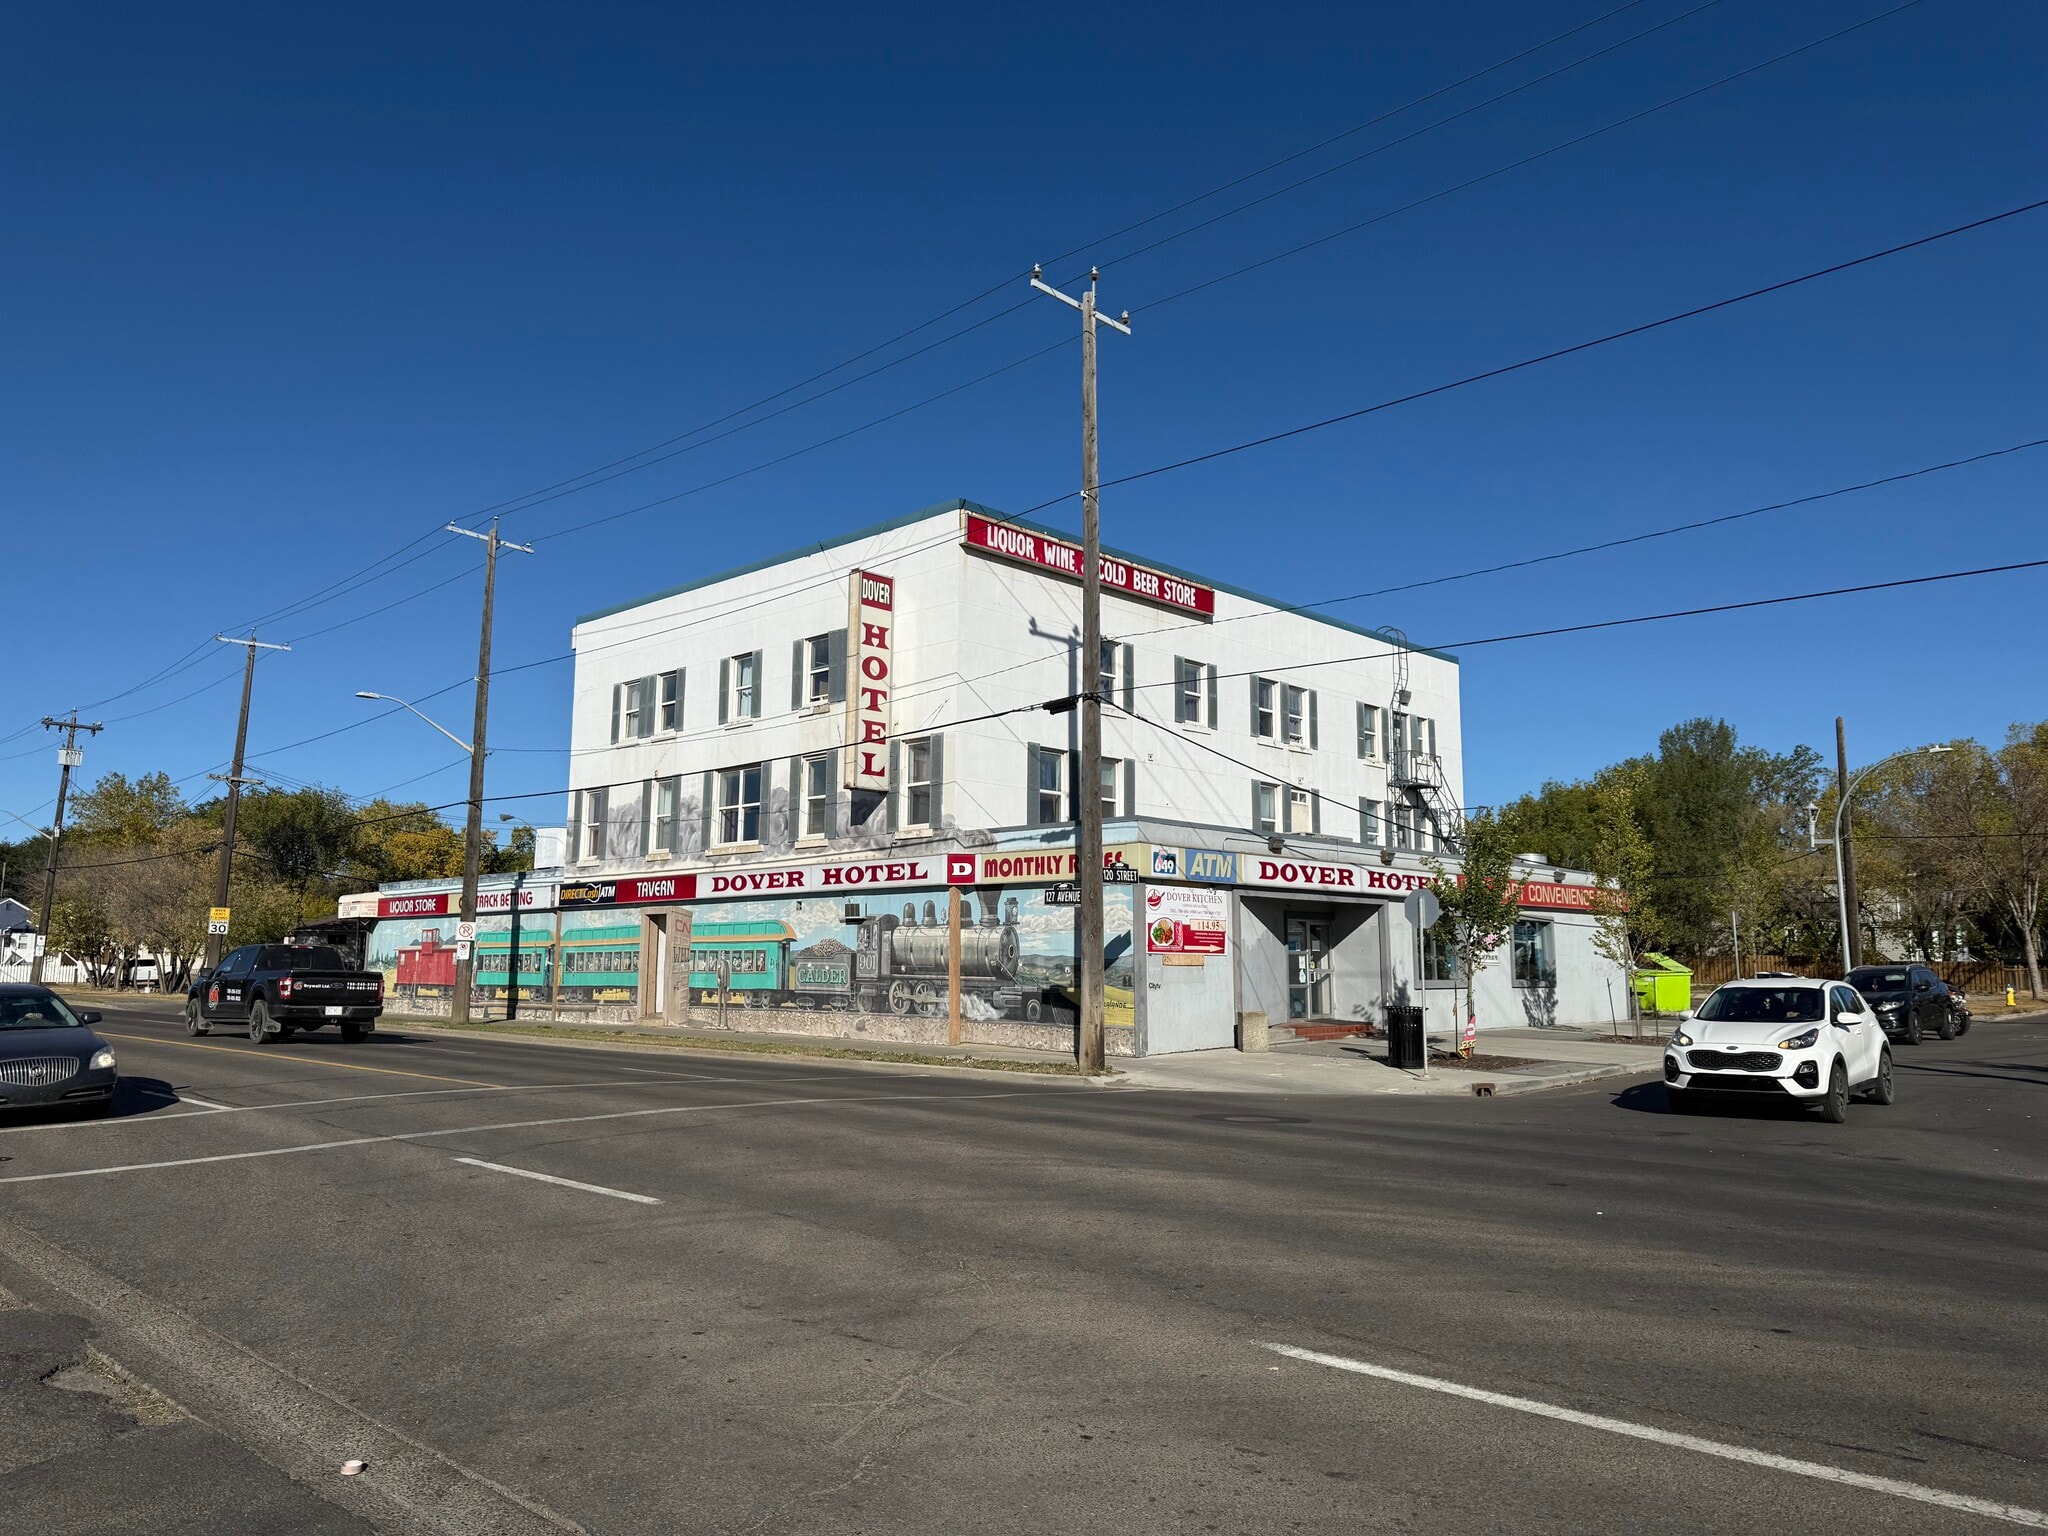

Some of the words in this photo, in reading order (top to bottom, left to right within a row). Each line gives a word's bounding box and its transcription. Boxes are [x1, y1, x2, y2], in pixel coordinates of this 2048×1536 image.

[986, 524, 1039, 562] LIQUOR,
[1043, 541, 1079, 574] WINE,
[1099, 558, 1127, 586] COLD
[1133, 569, 1160, 596] BEER
[1163, 580, 1196, 607] STORE
[862, 578, 890, 605] DOVER
[861, 622, 890, 777] HOTEL
[951, 863, 973, 876] D
[984, 855, 1064, 878] MONTHLY
[1189, 852, 1233, 878] ATM
[1258, 861, 1355, 887] DOVER
[711, 870, 805, 893] DOVER
[821, 862, 929, 886] HOTEL
[1116, 870, 1137, 882] STREET
[600, 885, 616, 898] ATM
[636, 879, 675, 898] TAVERN
[1046, 891, 1056, 902] 127
[1056, 890, 1081, 902] AVENUE
[1528, 885, 1595, 906] CONVENIENCE
[389, 900, 413, 914] LIQUOR
[415, 898, 436, 912] STORE
[476, 893, 498, 909] TRACK
[500, 891, 533, 907] BETTING
[1166, 892, 1191, 902] DOVER
[1192, 894, 1223, 904] KITCHEN
[210, 924, 227, 933] 30
[675, 919, 691, 935] CN
[859, 954, 876, 970] 901
[798, 966, 848, 985] CALDER
